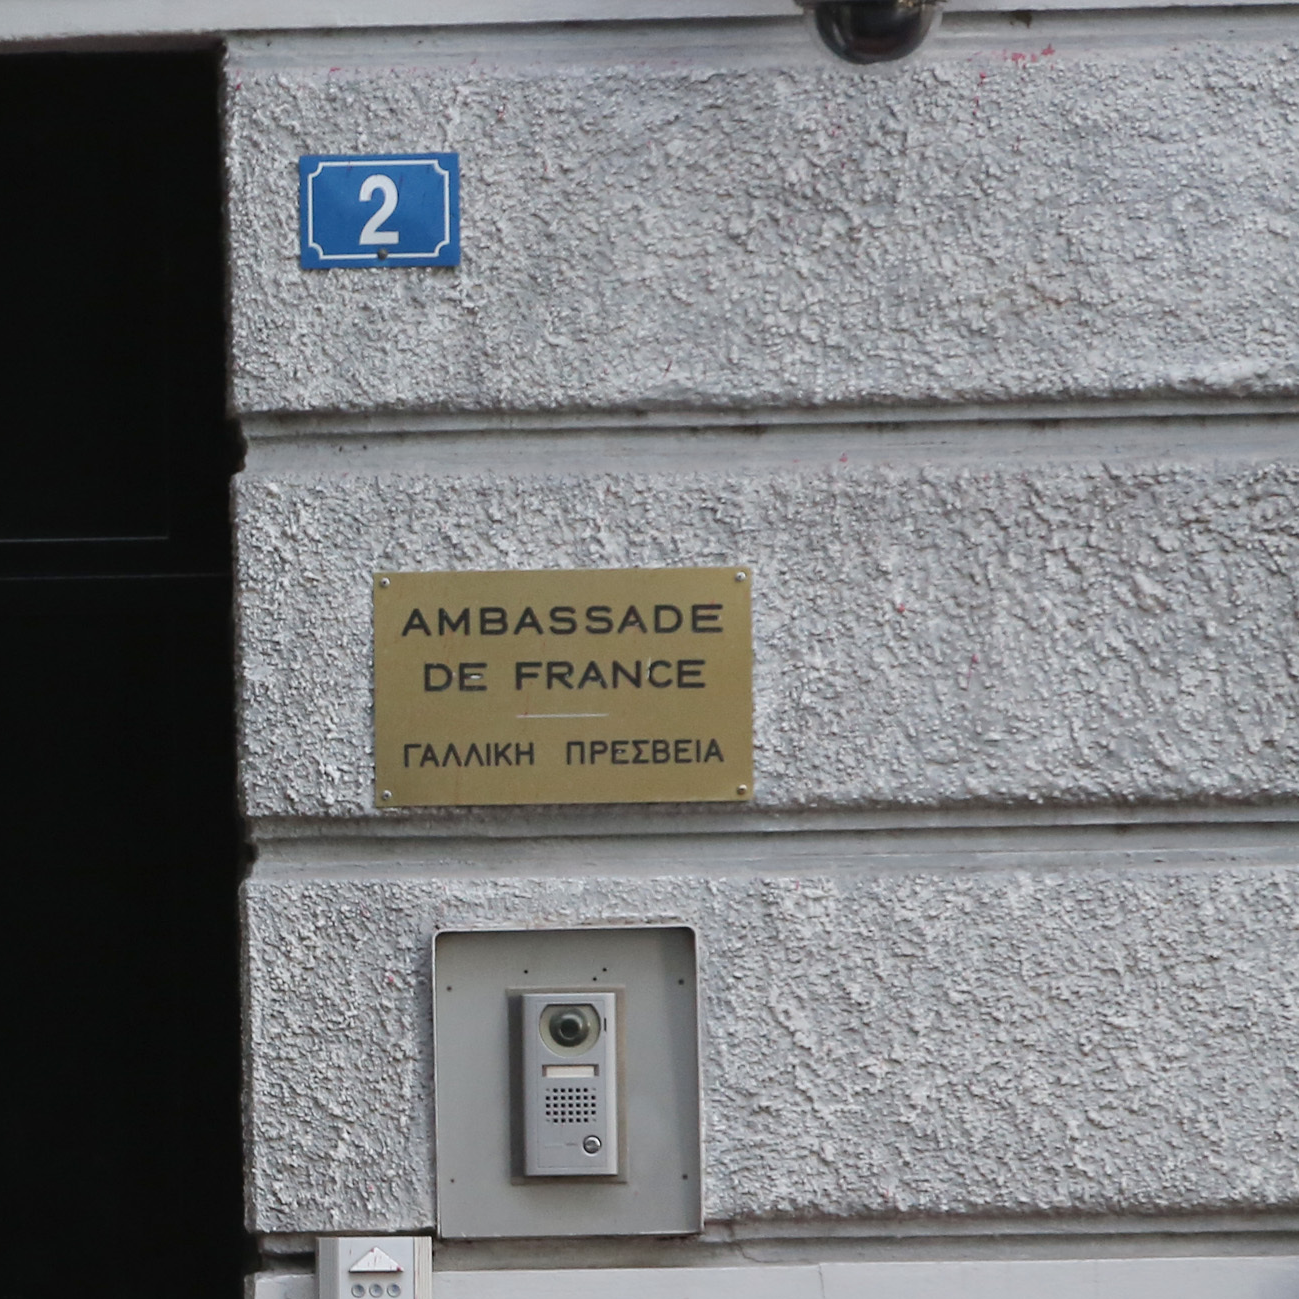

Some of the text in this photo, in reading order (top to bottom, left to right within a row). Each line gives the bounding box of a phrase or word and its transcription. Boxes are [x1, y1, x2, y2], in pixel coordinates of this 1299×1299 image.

[358, 173, 400, 246] 2
[401, 603, 724, 637] AMBASSADE
[423, 659, 707, 692] DE FRANCE
[403, 738, 725, 768] ΓΑΛΛΙΚΗ ΠΡΕΣΒΕΙΑ
